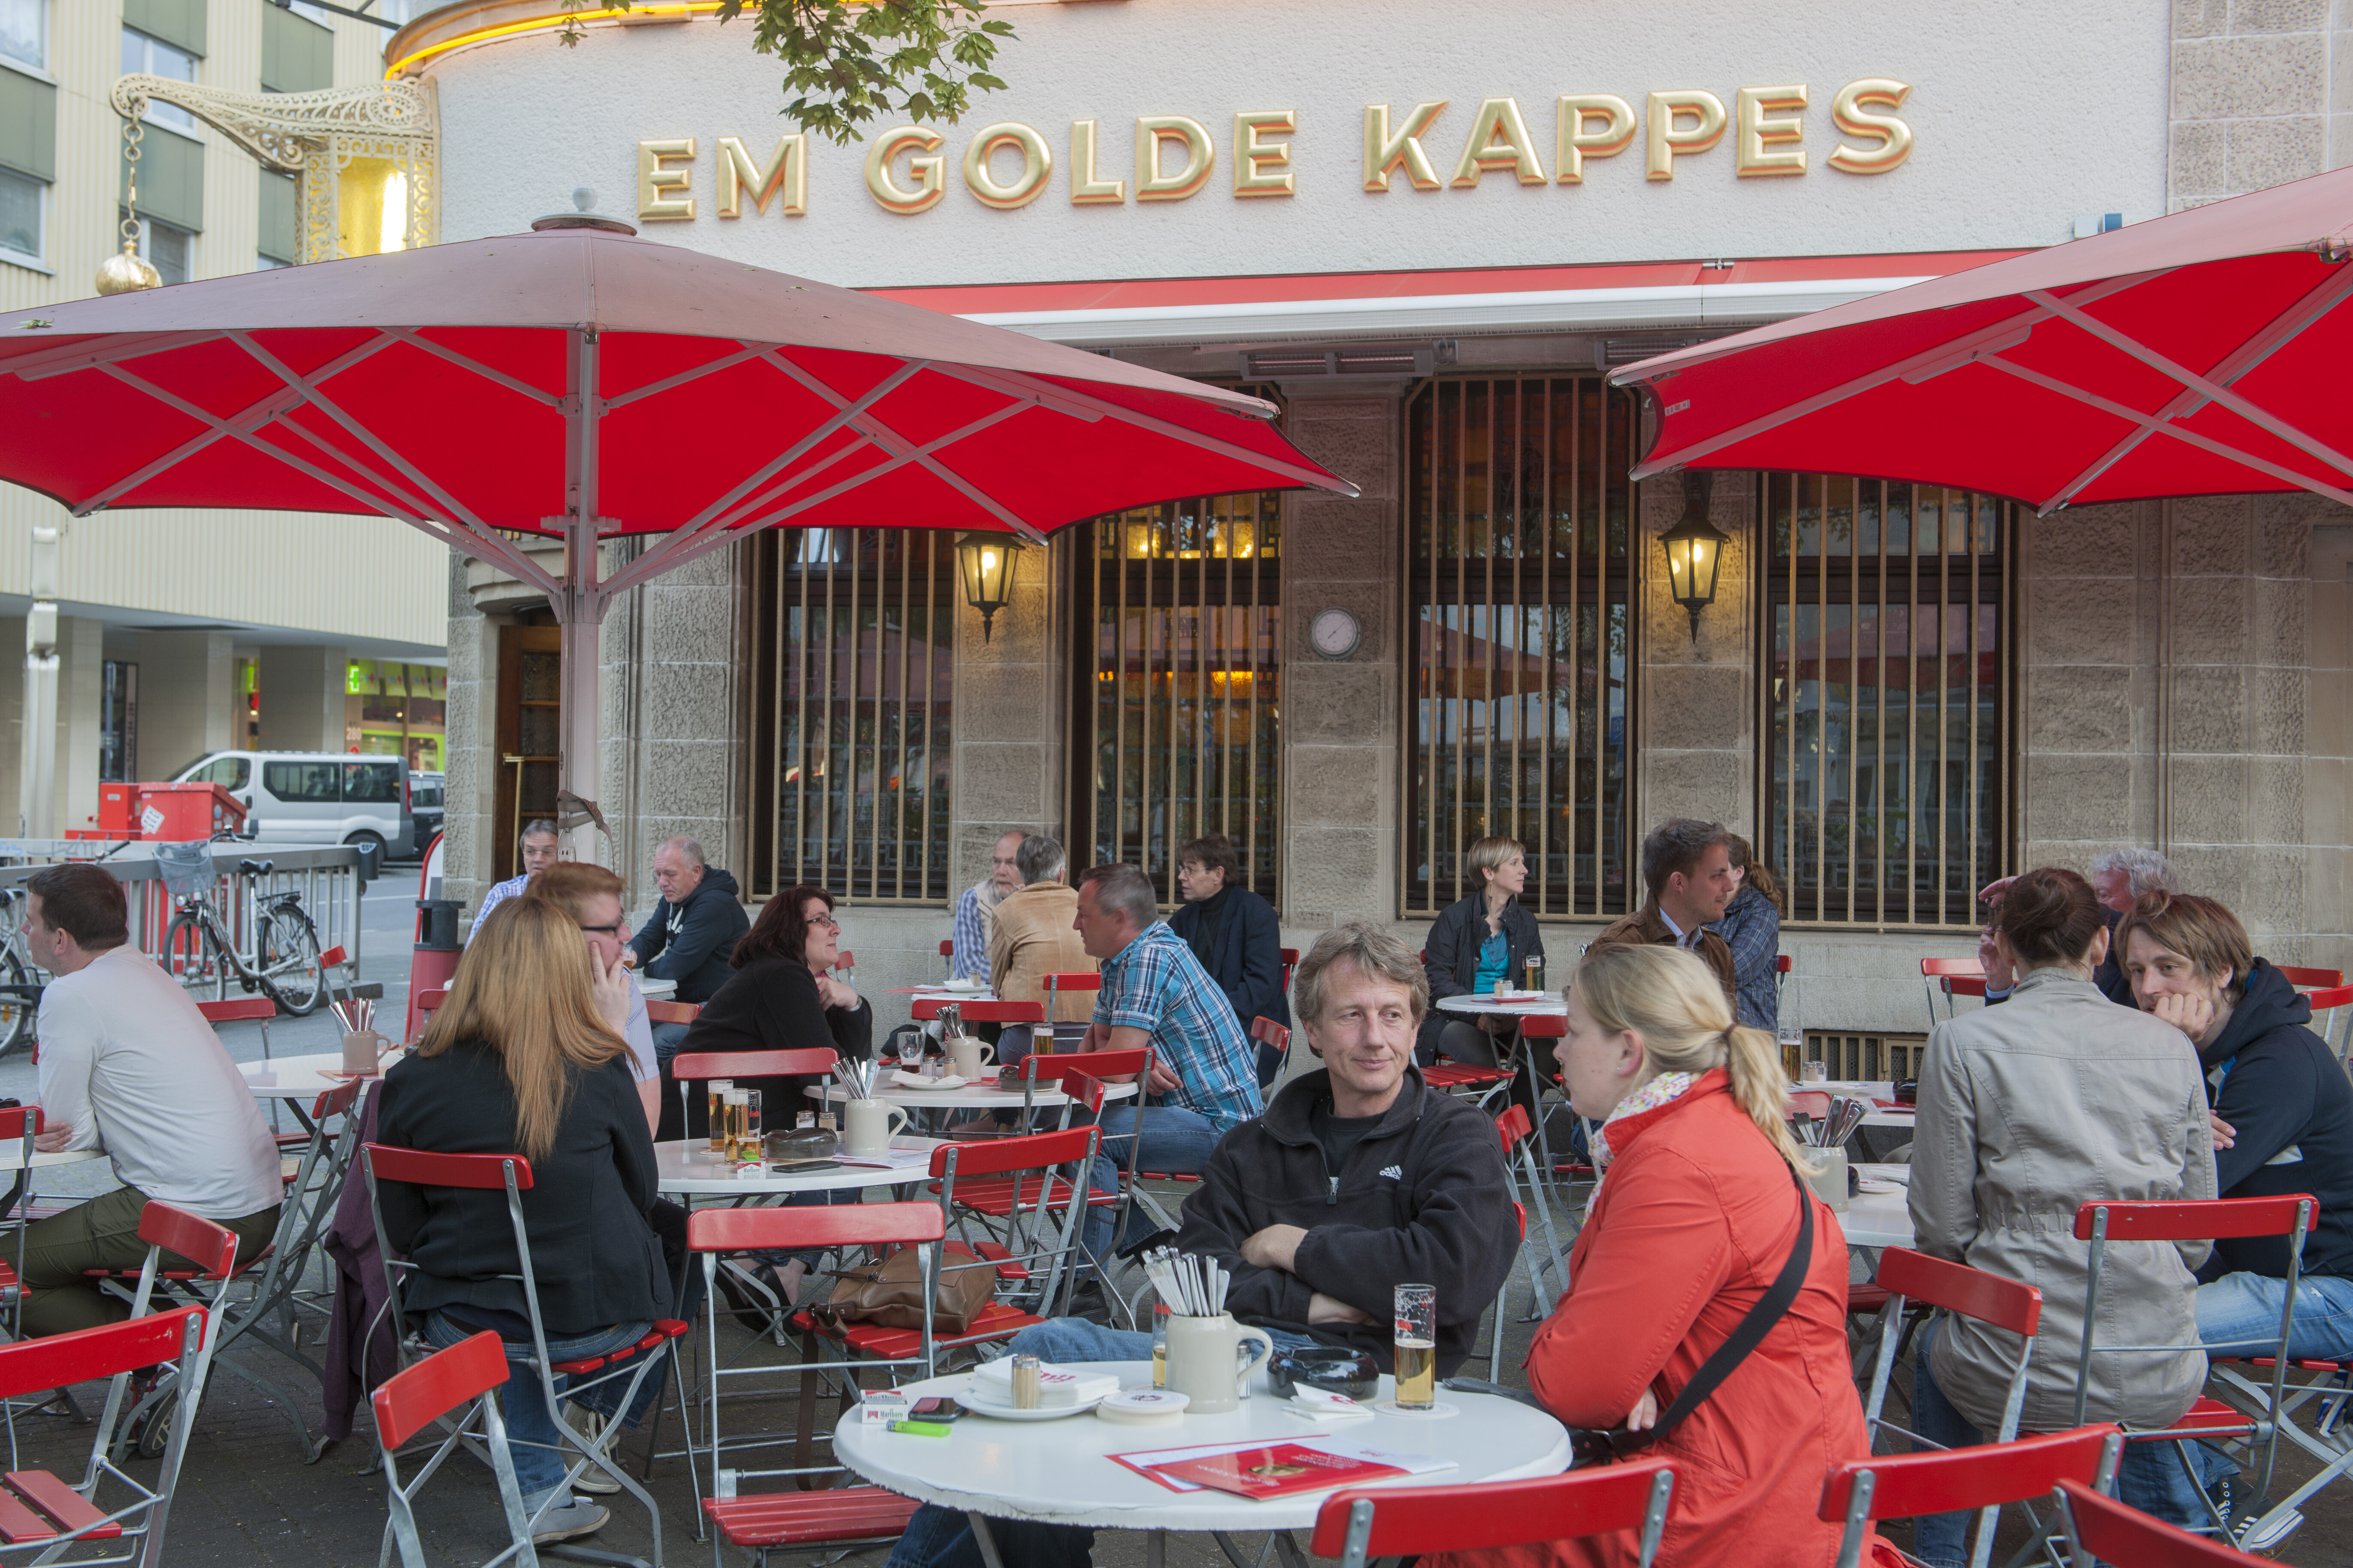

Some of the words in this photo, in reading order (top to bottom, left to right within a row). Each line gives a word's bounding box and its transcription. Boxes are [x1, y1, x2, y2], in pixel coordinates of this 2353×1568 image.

[637, 133, 808, 222] EM
[863, 109, 1296, 215] GOLDE
[1362, 77, 1914, 193] KAPPES
[346, 727, 362, 741] 280
[880, 1408, 903, 1418] Marlboro
